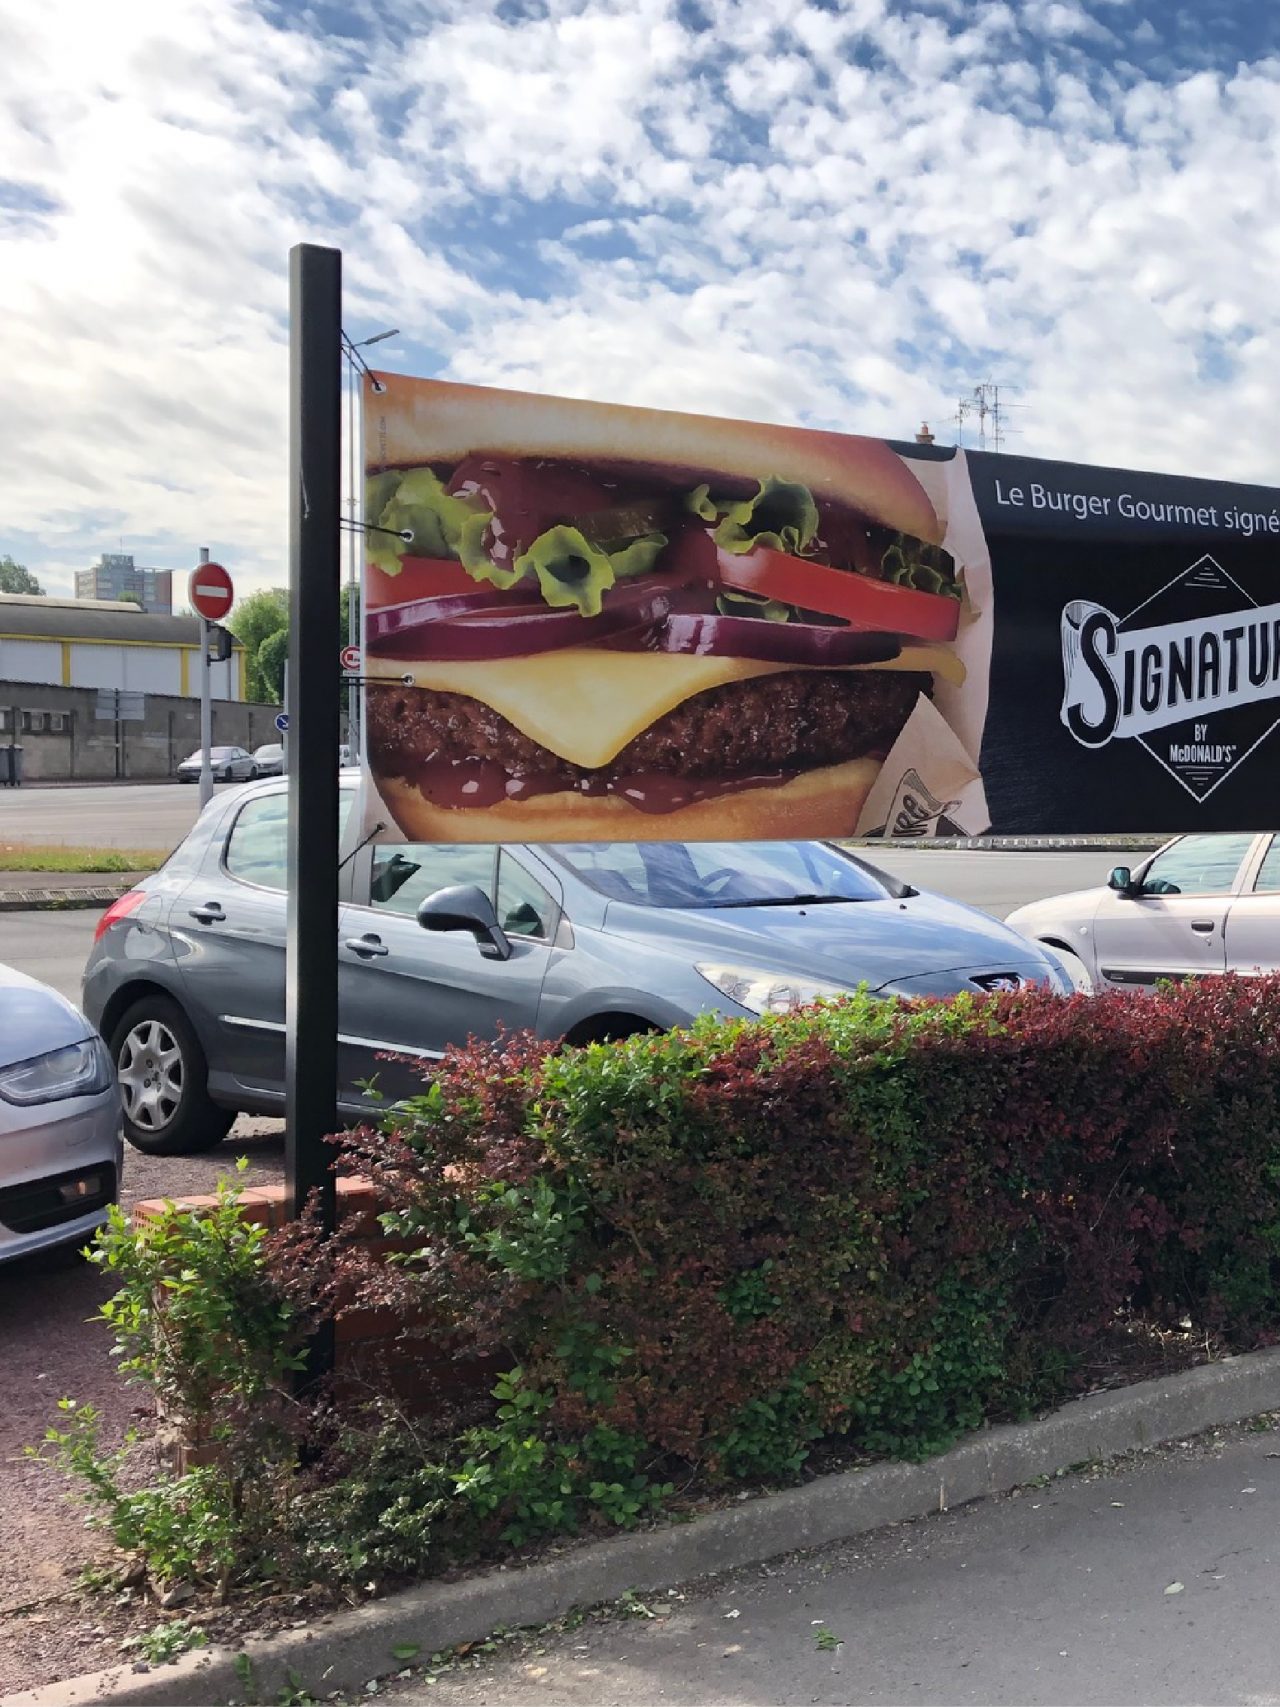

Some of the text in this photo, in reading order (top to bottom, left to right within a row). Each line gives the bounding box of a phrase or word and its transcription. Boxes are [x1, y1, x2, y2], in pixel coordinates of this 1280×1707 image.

[995, 479, 1024, 506] Le
[1030, 483, 1111, 520] Burger
[1118, 494, 1219, 527] Gourmet
[1224, 506, 1280, 536] signé
[1194, 724, 1208, 742] BY
